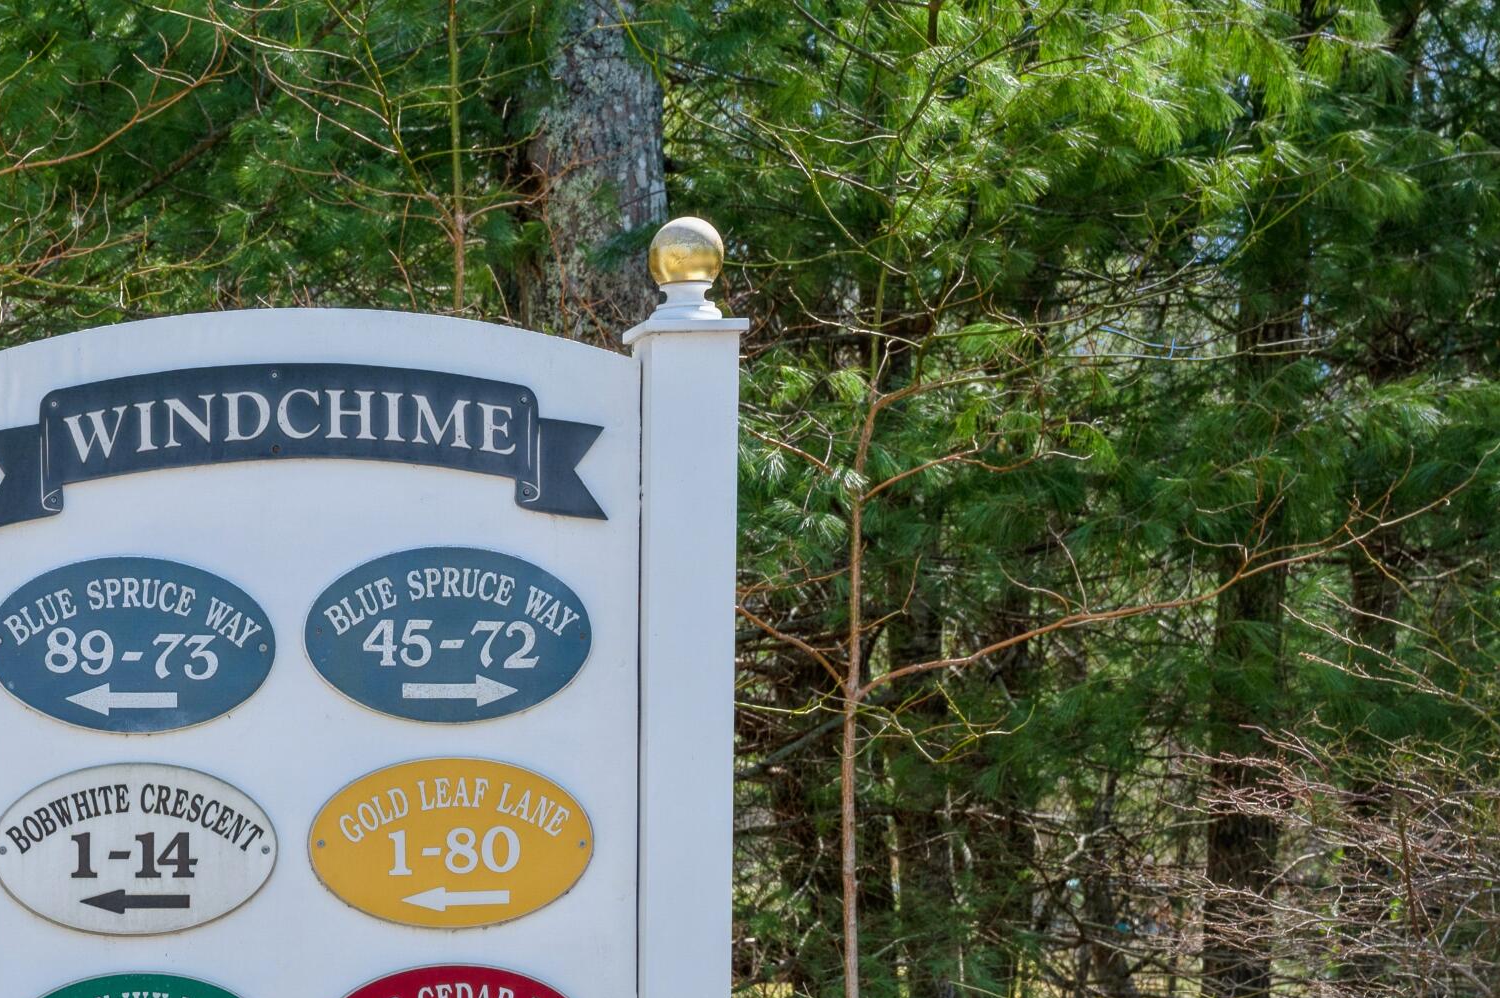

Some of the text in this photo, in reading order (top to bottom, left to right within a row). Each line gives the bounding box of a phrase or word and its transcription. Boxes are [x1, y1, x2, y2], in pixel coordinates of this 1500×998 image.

[63, 387, 517, 463] WINDCHIME
[3, 578, 263, 649] BLUE SPRUCE WAY
[323, 567, 580, 636] BLUE SPRUCE WAY
[44, 628, 219, 680] 89-73
[362, 620, 540, 669] 45-72
[6, 783, 265, 855] BOBWHITE CRESCENT
[338, 777, 570, 844] GOLD LEAF LANE
[70, 831, 198, 879] 1-14
[387, 826, 520, 877] 1-80
